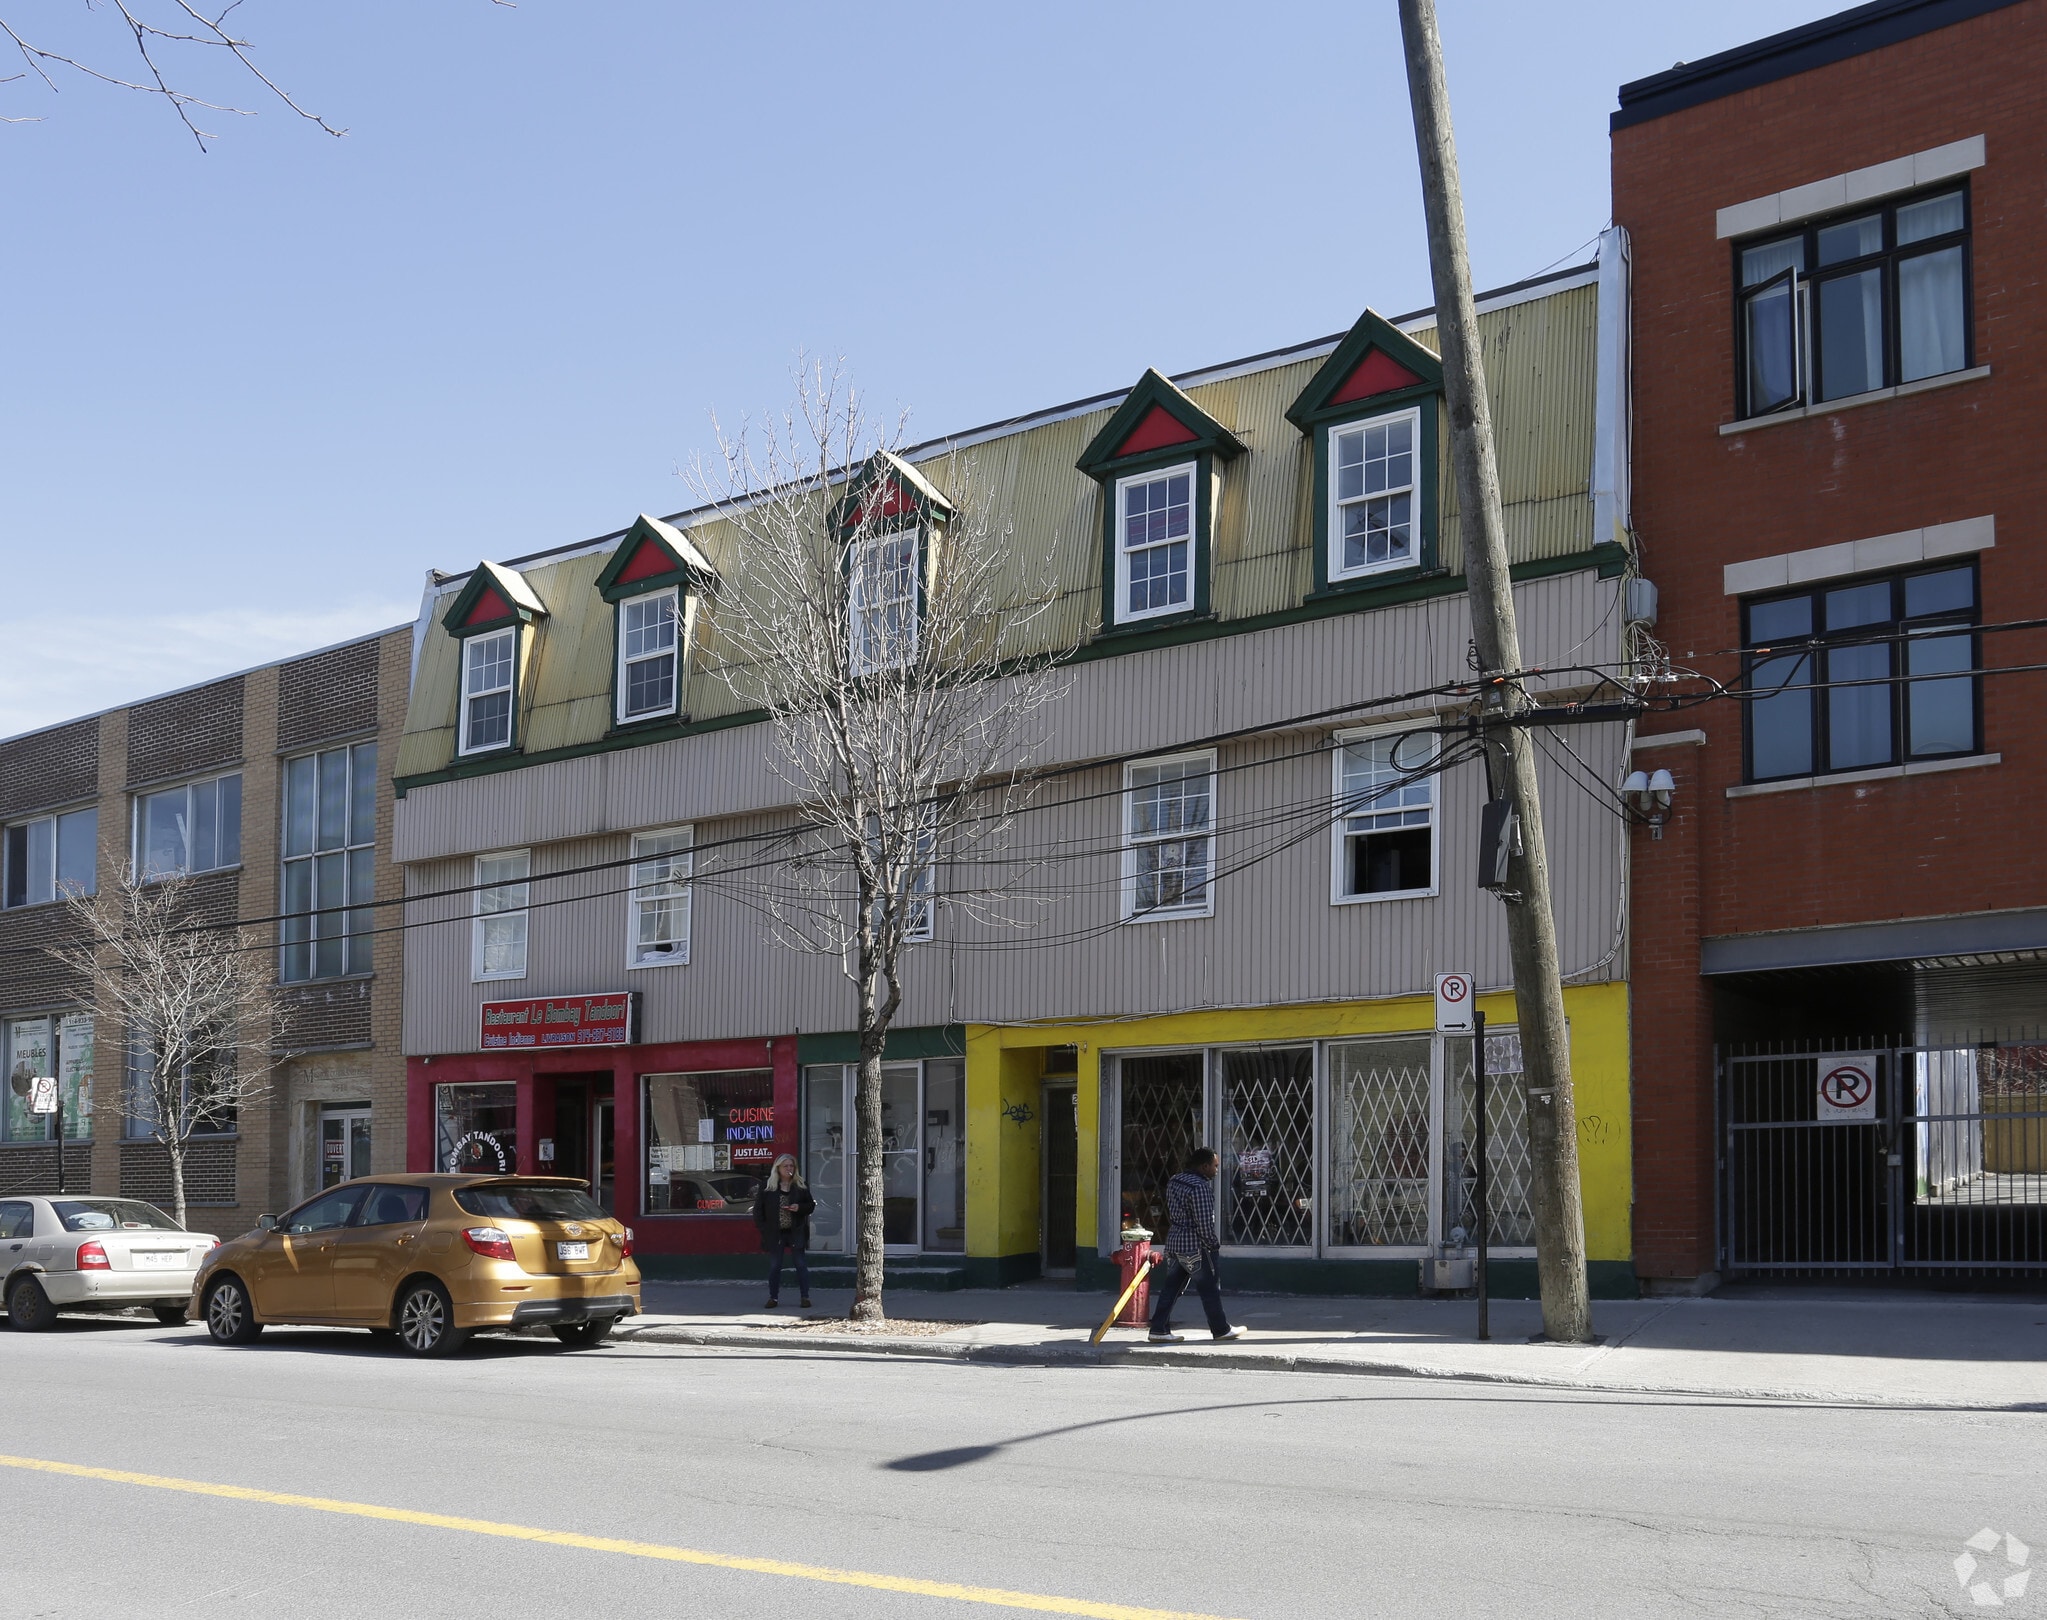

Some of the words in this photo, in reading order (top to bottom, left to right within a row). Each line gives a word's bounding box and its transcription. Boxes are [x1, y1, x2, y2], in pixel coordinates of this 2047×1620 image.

[485, 1007, 528, 1025] Restaurant
[530, 1004, 542, 1024] Le
[545, 1001, 581, 1027] Bombay
[584, 999, 626, 1022] Tandoori
[484, 1033, 507, 1046] Cuisine
[508, 1031, 536, 1045] Indienne
[541, 1032, 576, 1044] LIVRAISON
[16, 1048, 46, 1059] MEUBLES
[729, 1106, 775, 1124] CUISINE
[449, 1132, 471, 1174] BOMBAY
[473, 1131, 506, 1172] TANDOORI
[734, 1148, 753, 1157] JUST
[697, 1199, 725, 1210] OUVERT
